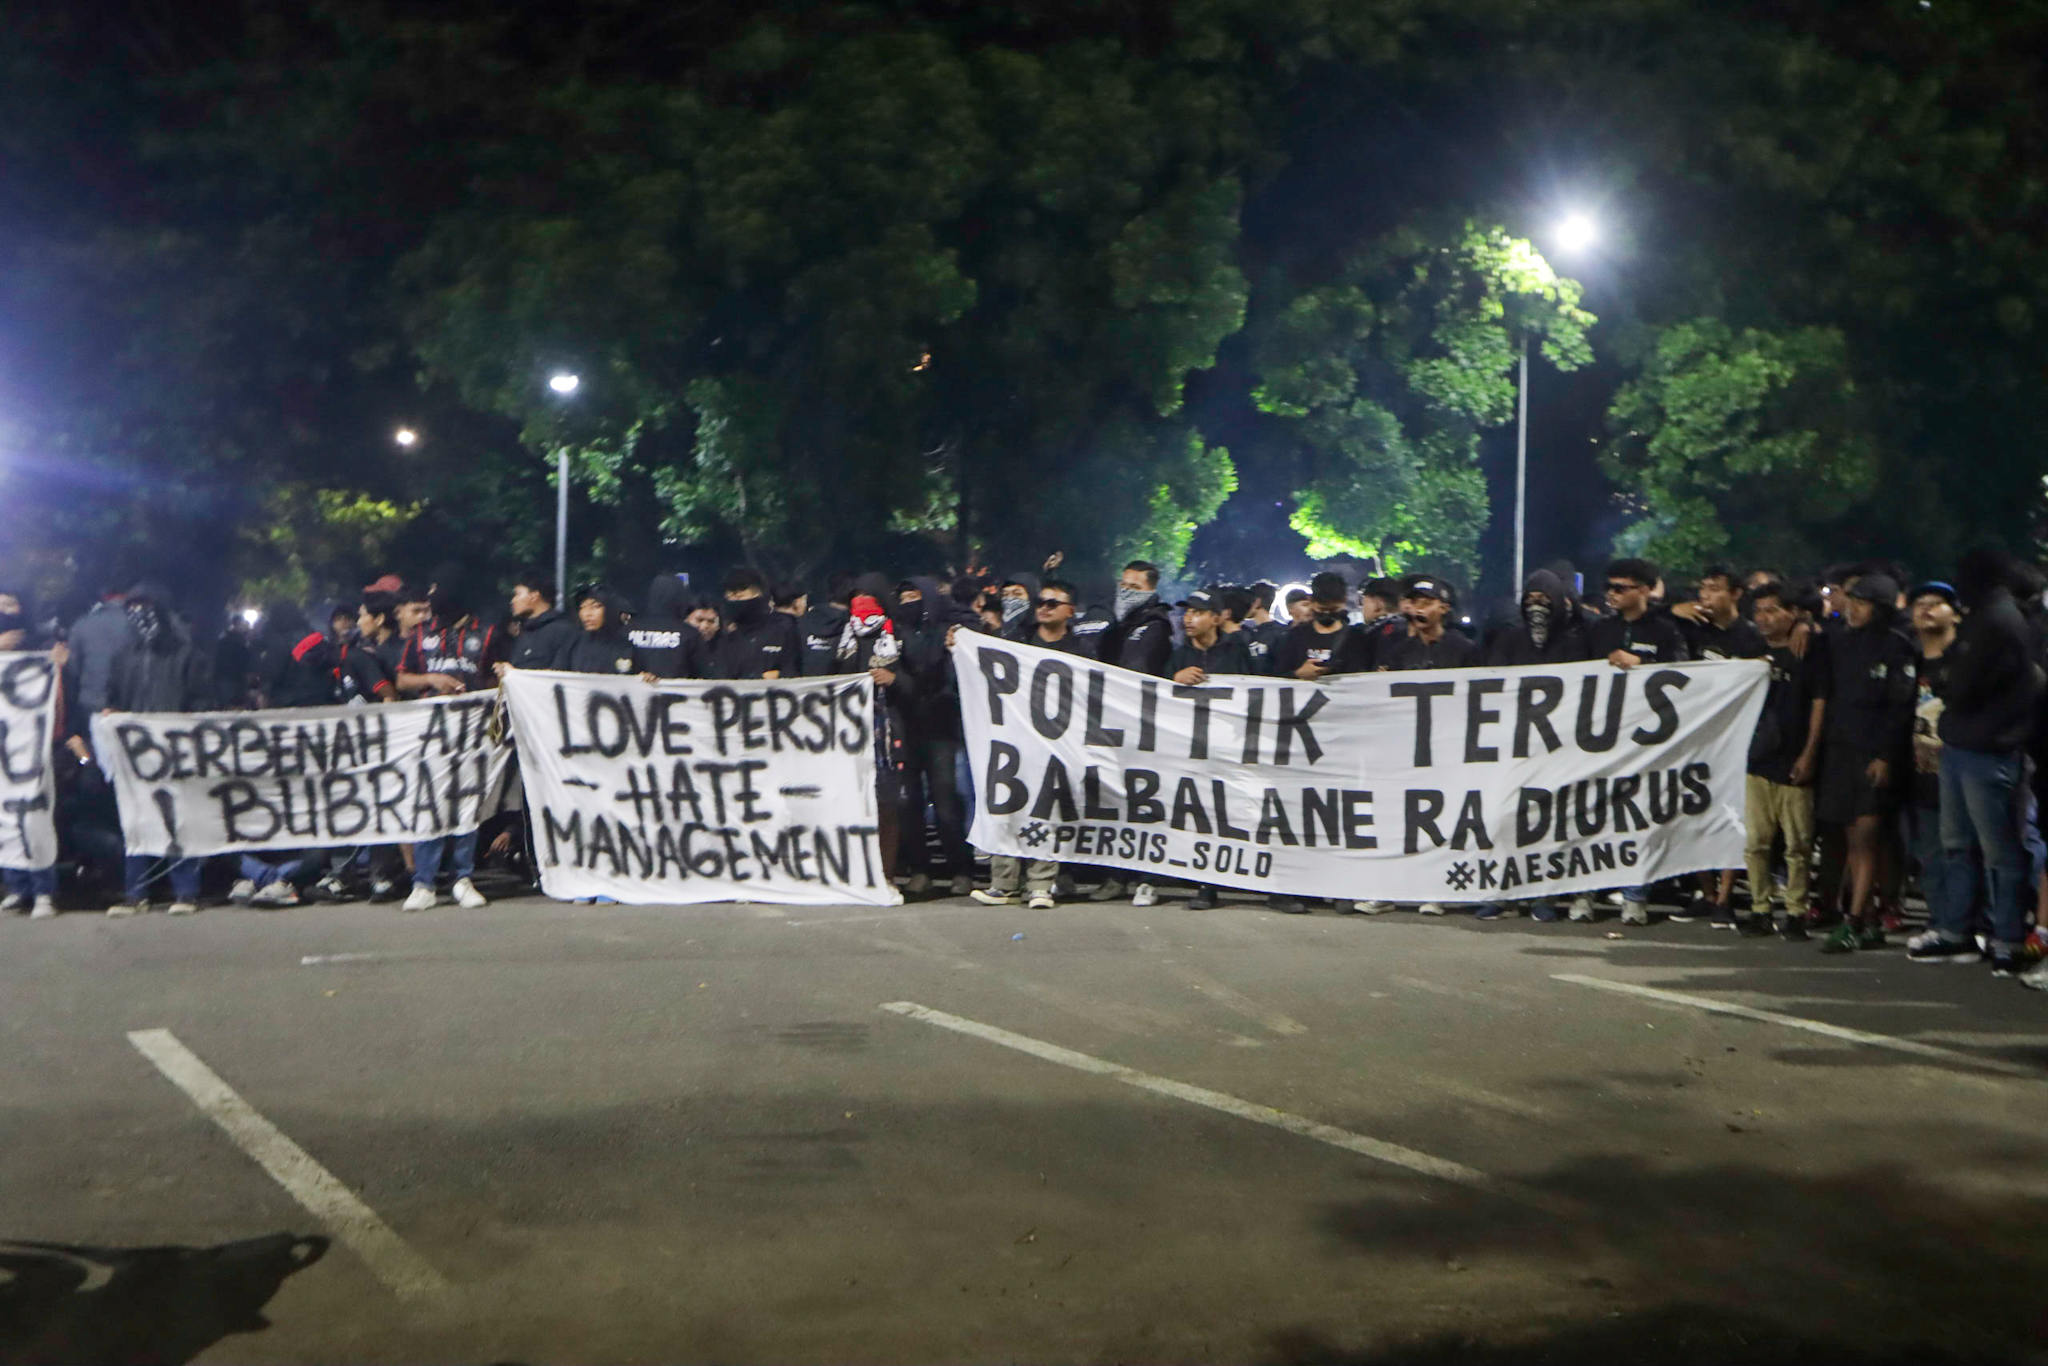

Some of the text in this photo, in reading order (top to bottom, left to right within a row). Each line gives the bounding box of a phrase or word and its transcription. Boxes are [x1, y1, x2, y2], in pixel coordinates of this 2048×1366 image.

[553, 683, 869, 758] LOVE PERSIS
[977, 646, 1690, 767] POLITIK TERUS
[116, 711, 387, 781] BERBENAH
[208, 752, 488, 842] BUBRAH
[615, 760, 772, 824] HATE
[986, 740, 1712, 854] BALBALANE RA DIURUS
[541, 806, 878, 888] MANAGEMENT
[1445, 840, 1639, 891] #KAESANG
